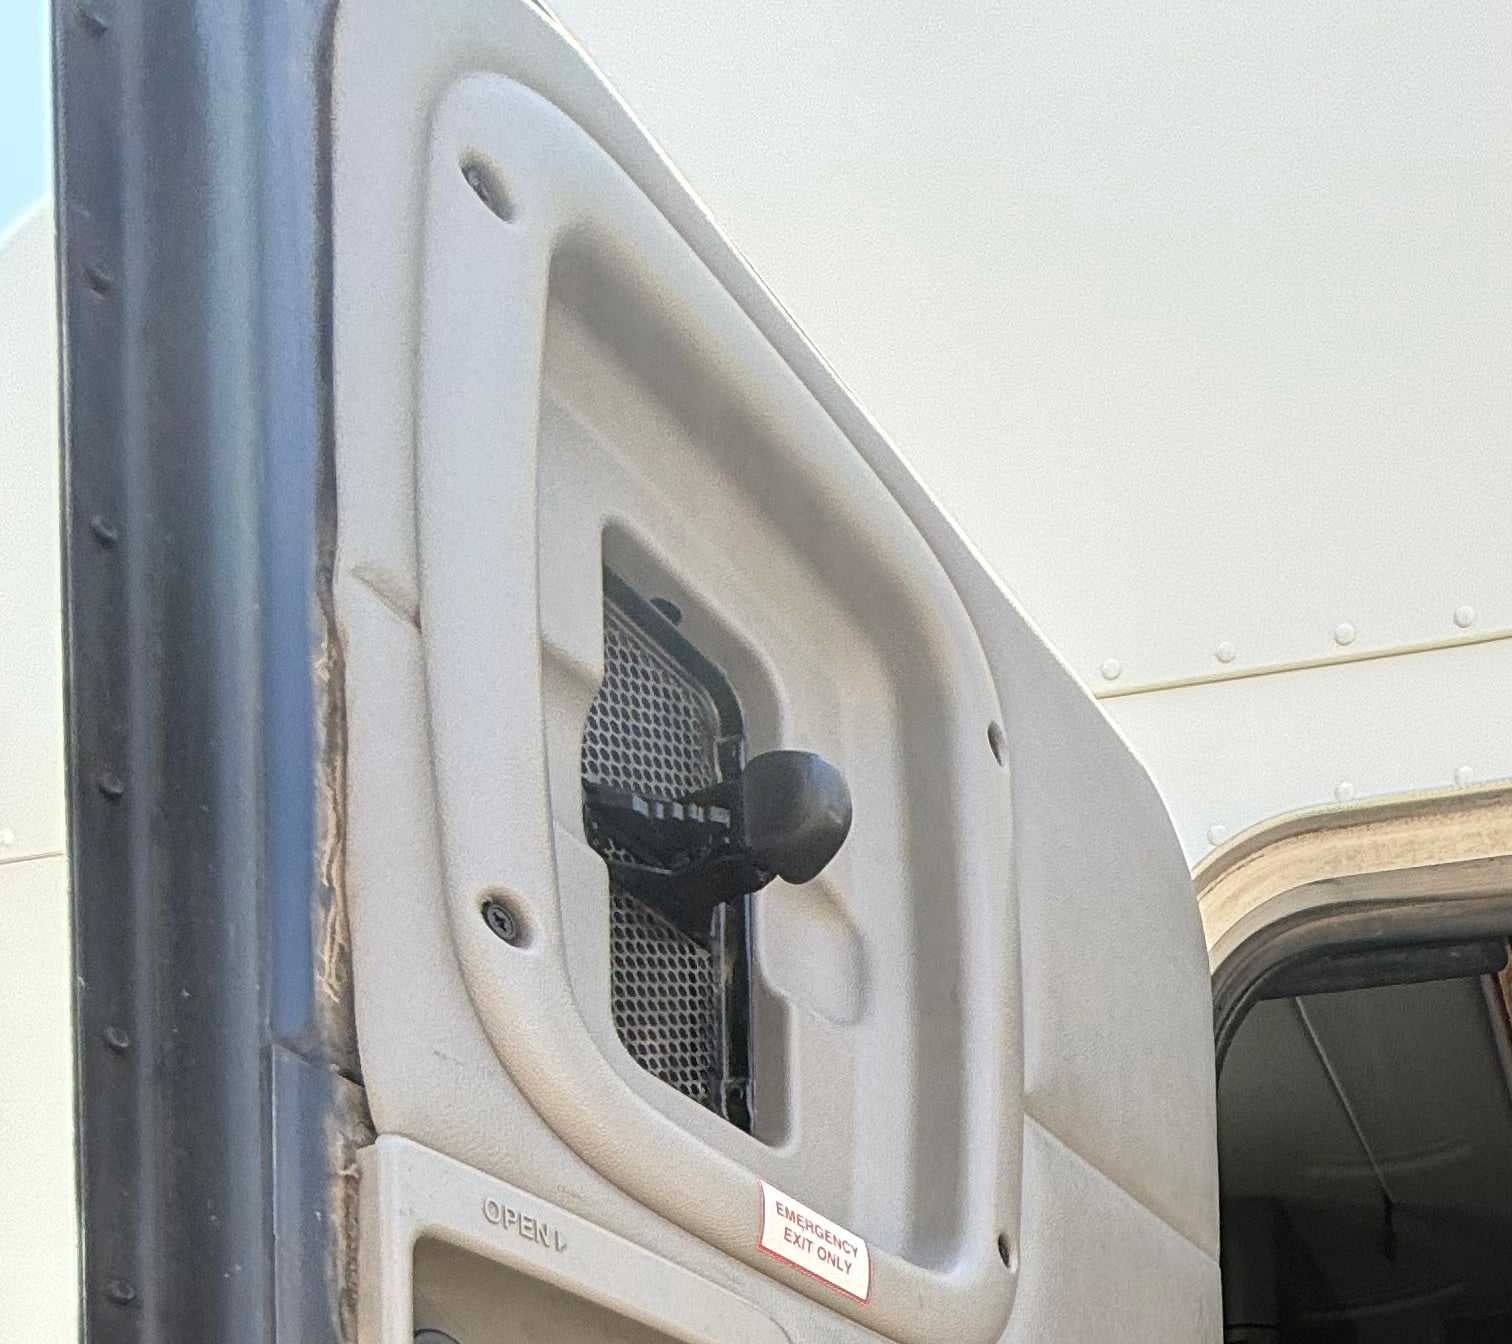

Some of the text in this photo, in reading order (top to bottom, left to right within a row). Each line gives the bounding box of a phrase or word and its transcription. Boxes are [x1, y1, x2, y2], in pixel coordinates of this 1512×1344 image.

[483, 1198, 550, 1249] OPEN
[775, 1200, 858, 1259] EMERGENCY
[783, 1226, 852, 1275] EXIT ONLY
